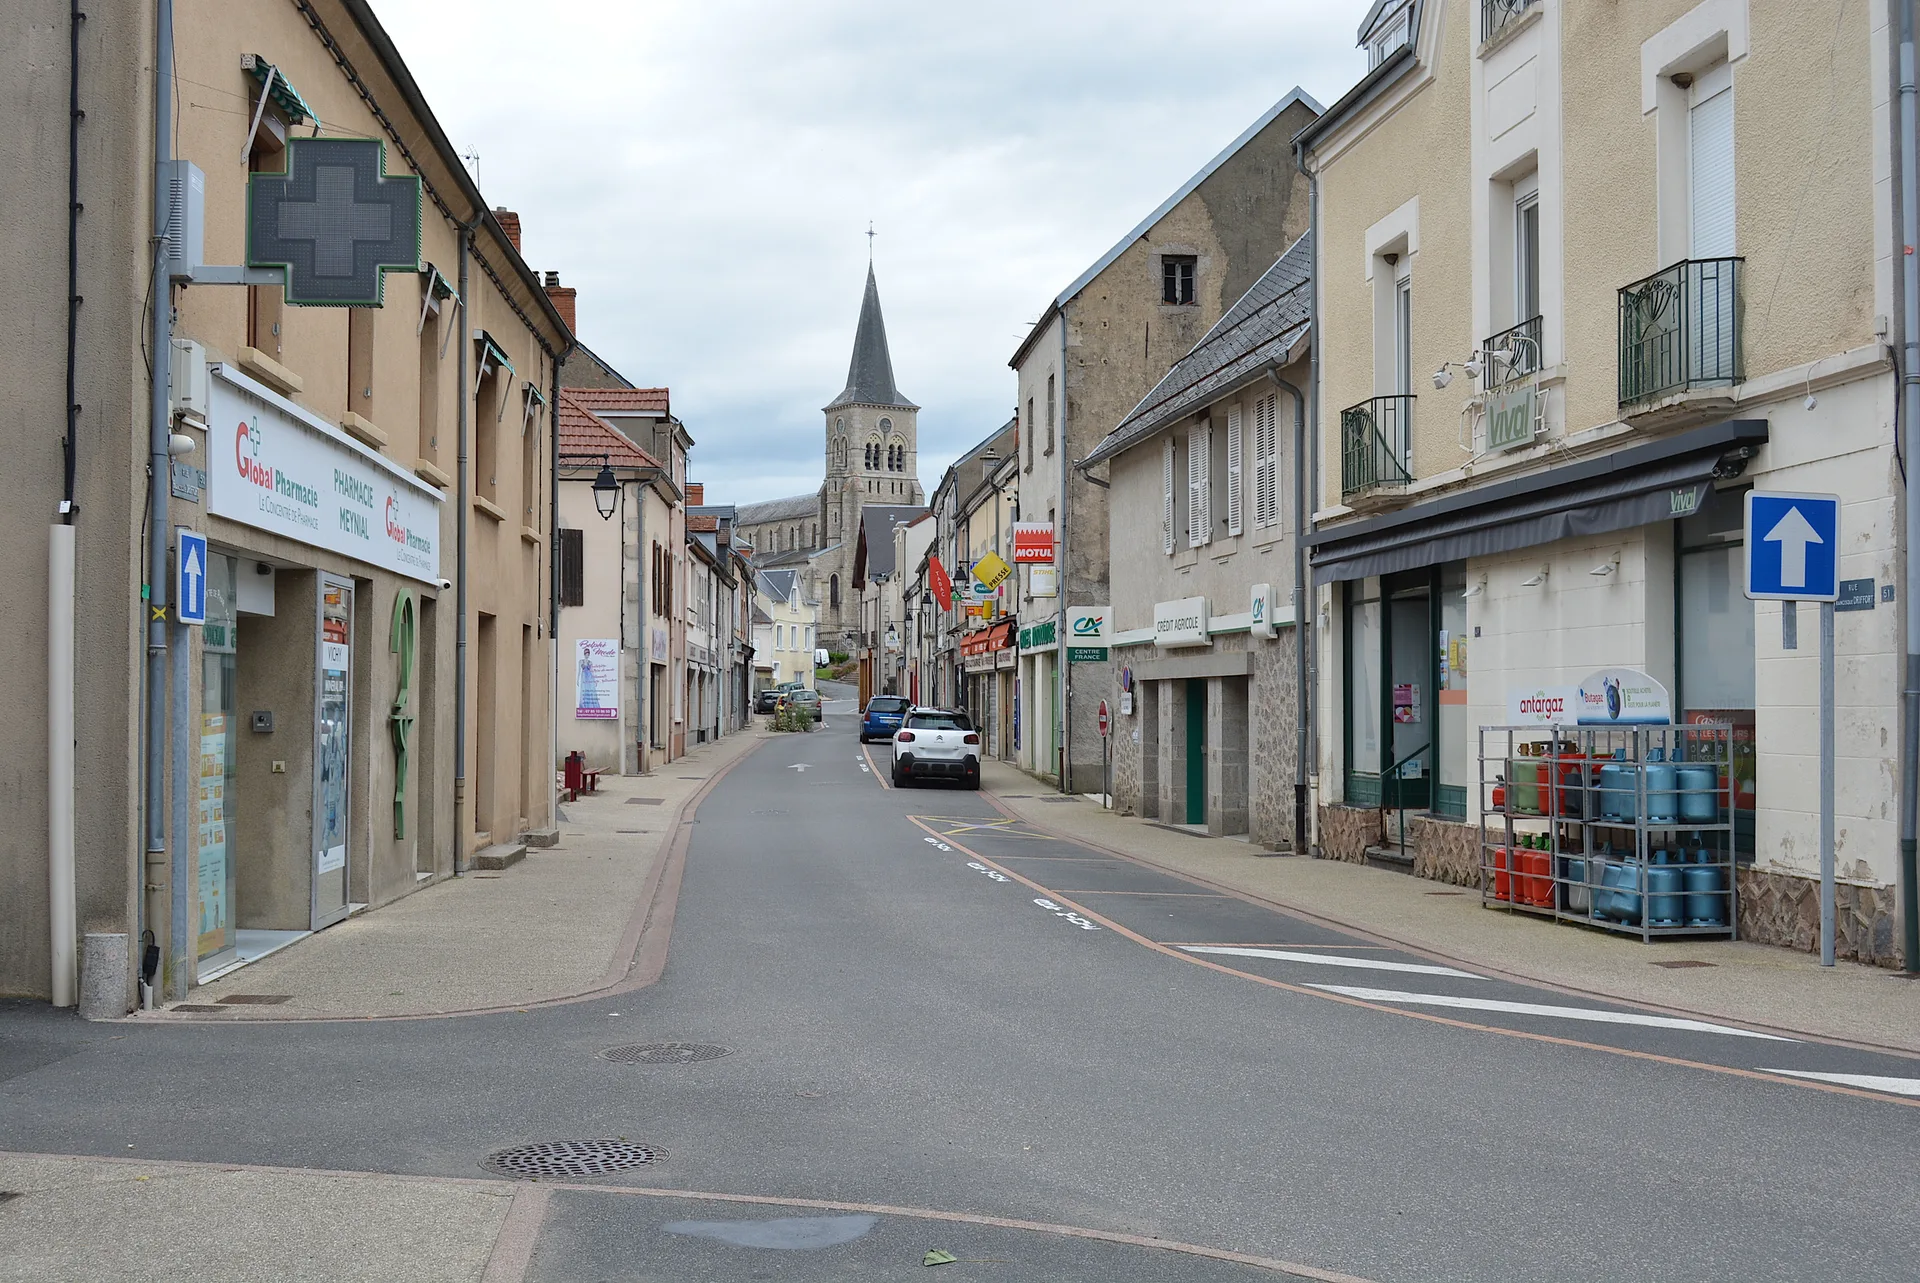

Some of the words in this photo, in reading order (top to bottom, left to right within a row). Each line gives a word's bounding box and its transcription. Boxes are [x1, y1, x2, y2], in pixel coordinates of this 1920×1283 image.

[1489, 392, 1531, 446] Vival
[235, 421, 273, 490] Global
[275, 469, 318, 508] Pharmacie
[333, 468, 374, 509] PHARMACIE
[1670, 486, 1697, 512] Vival
[339, 506, 370, 541] MEYNIAL
[385, 495, 406, 545] Global
[406, 528, 431, 555] Pharmacie
[1016, 548, 1053, 557] MOTUL
[935, 571, 946, 597] TABAC
[988, 566, 1009, 588] PRESSE
[1848, 583, 1859, 592] RUE
[1853, 594, 1874, 605] DRIFFORT
[1883, 589, 1890, 598] 51
[1156, 618, 1174, 633] CRÉDIT
[1174, 616, 1199, 631] AGRICOLE
[327, 645, 343, 662] VICHY
[1519, 695, 1564, 719] antargaz
[1584, 692, 1604, 705] Butagaz
[1703, 729, 1717, 738] LES
